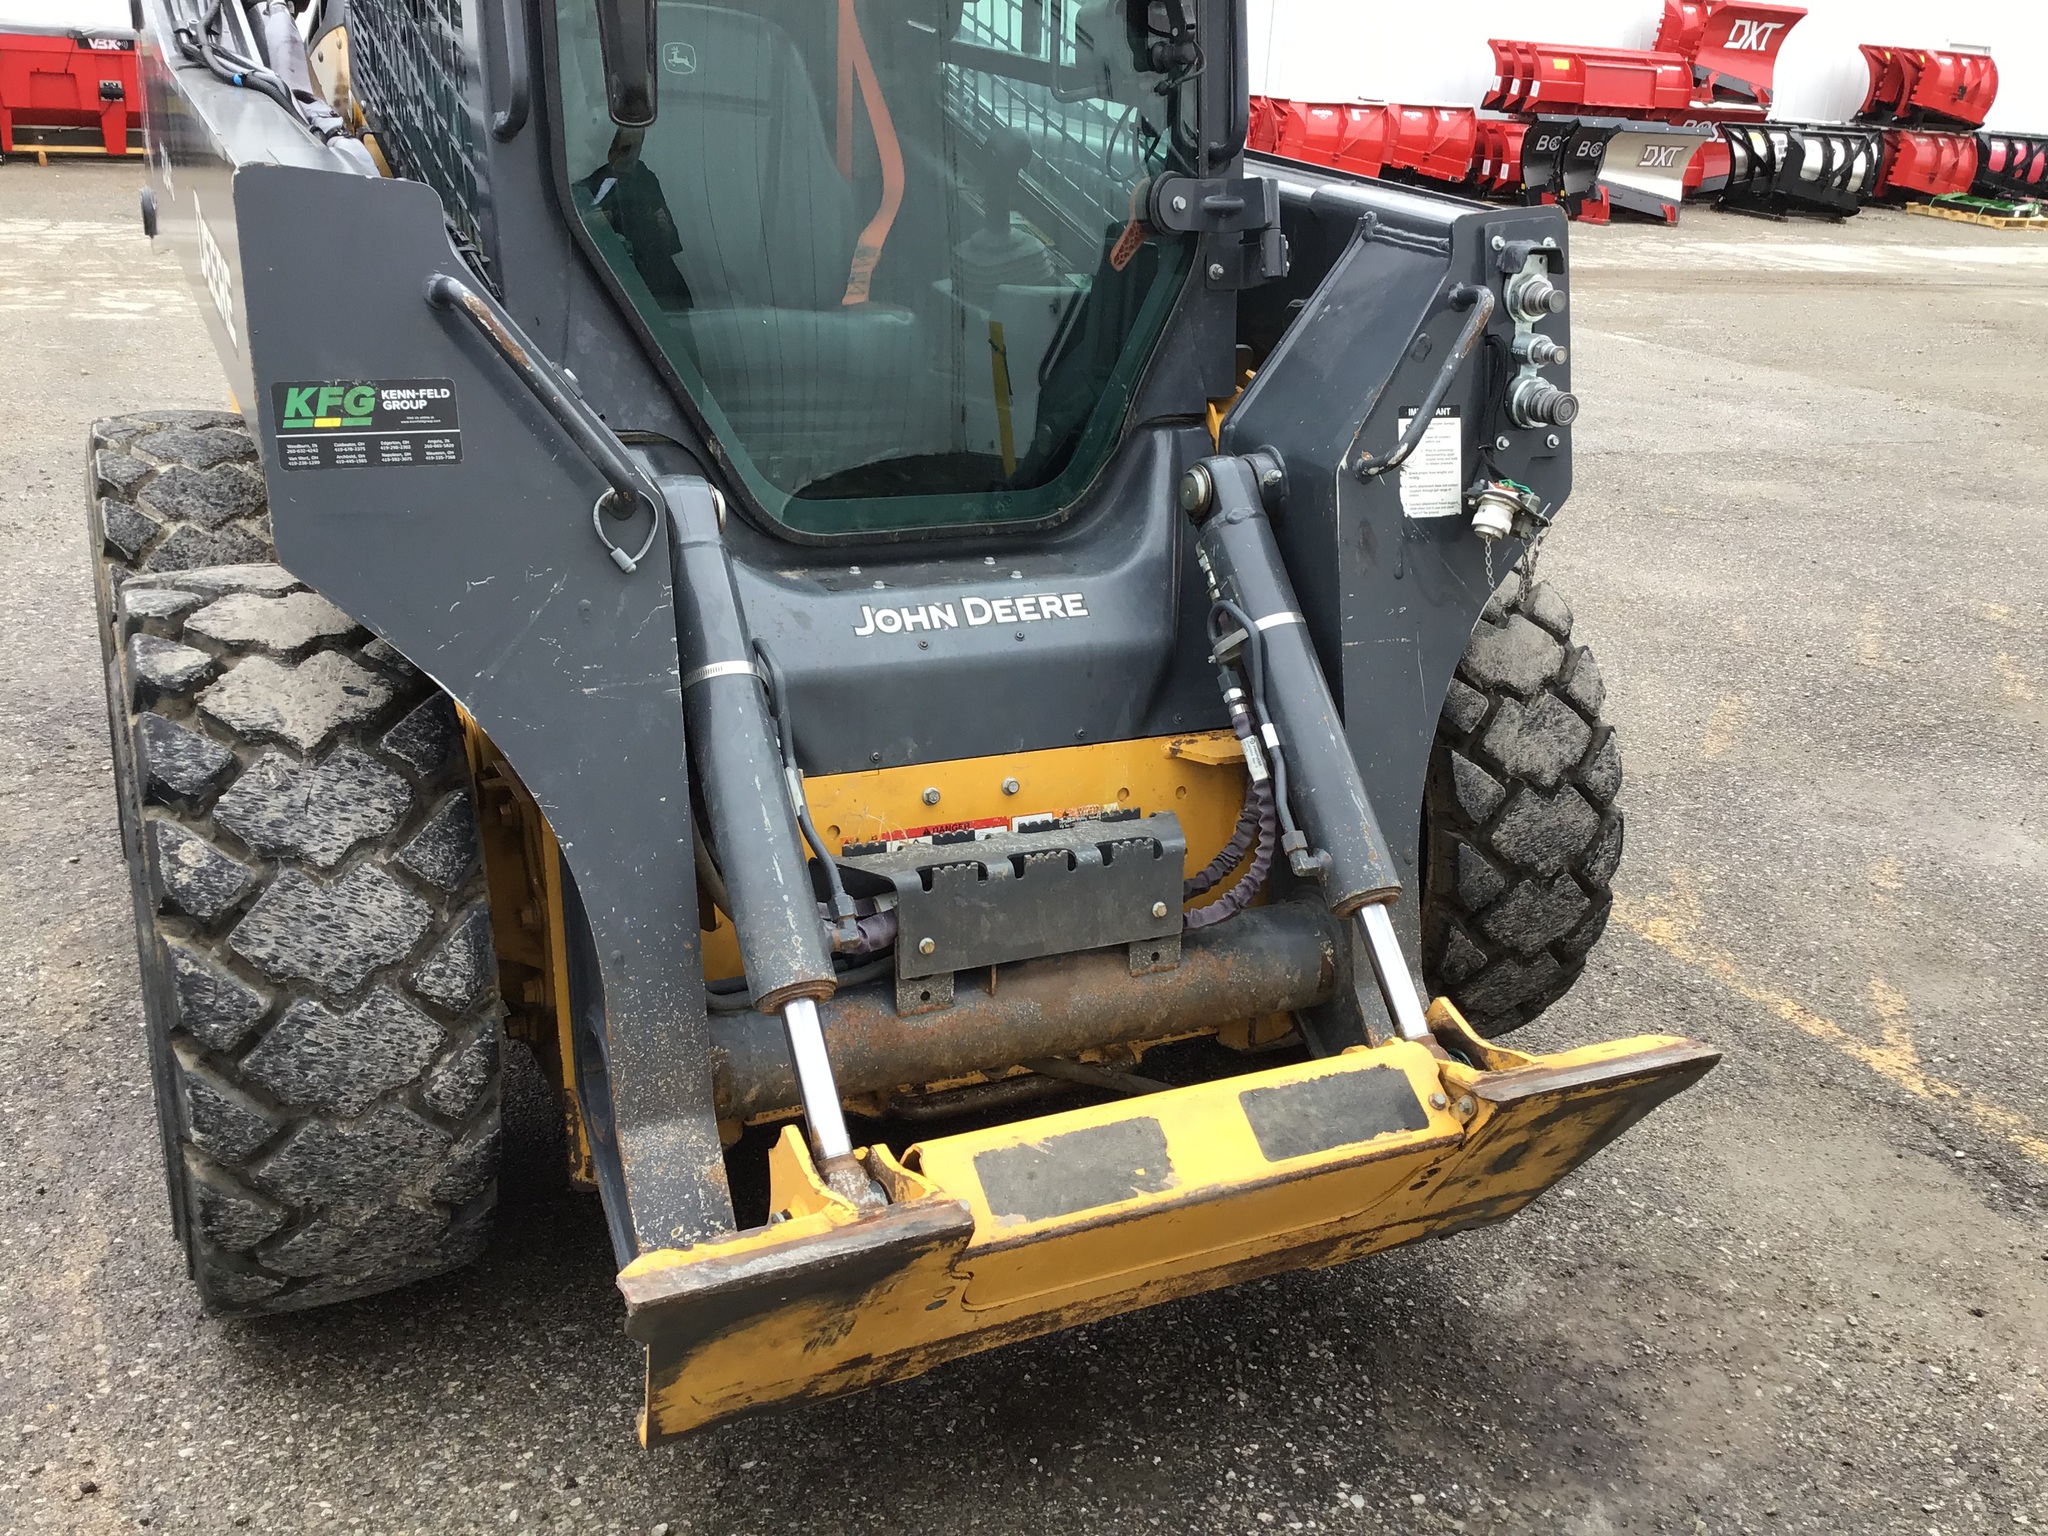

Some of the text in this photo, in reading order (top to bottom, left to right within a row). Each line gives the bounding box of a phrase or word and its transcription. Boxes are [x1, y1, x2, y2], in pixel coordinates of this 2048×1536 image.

[1723, 19, 1785, 51] DXT
[1639, 145, 1686, 167] DXT
[284, 385, 376, 418] KFG
[381, 388, 450, 401] KENN-FELD
[383, 399, 428, 411] GROUP
[1408, 407, 1451, 416] IMANT
[855, 592, 1089, 637] JOHN DEERE
